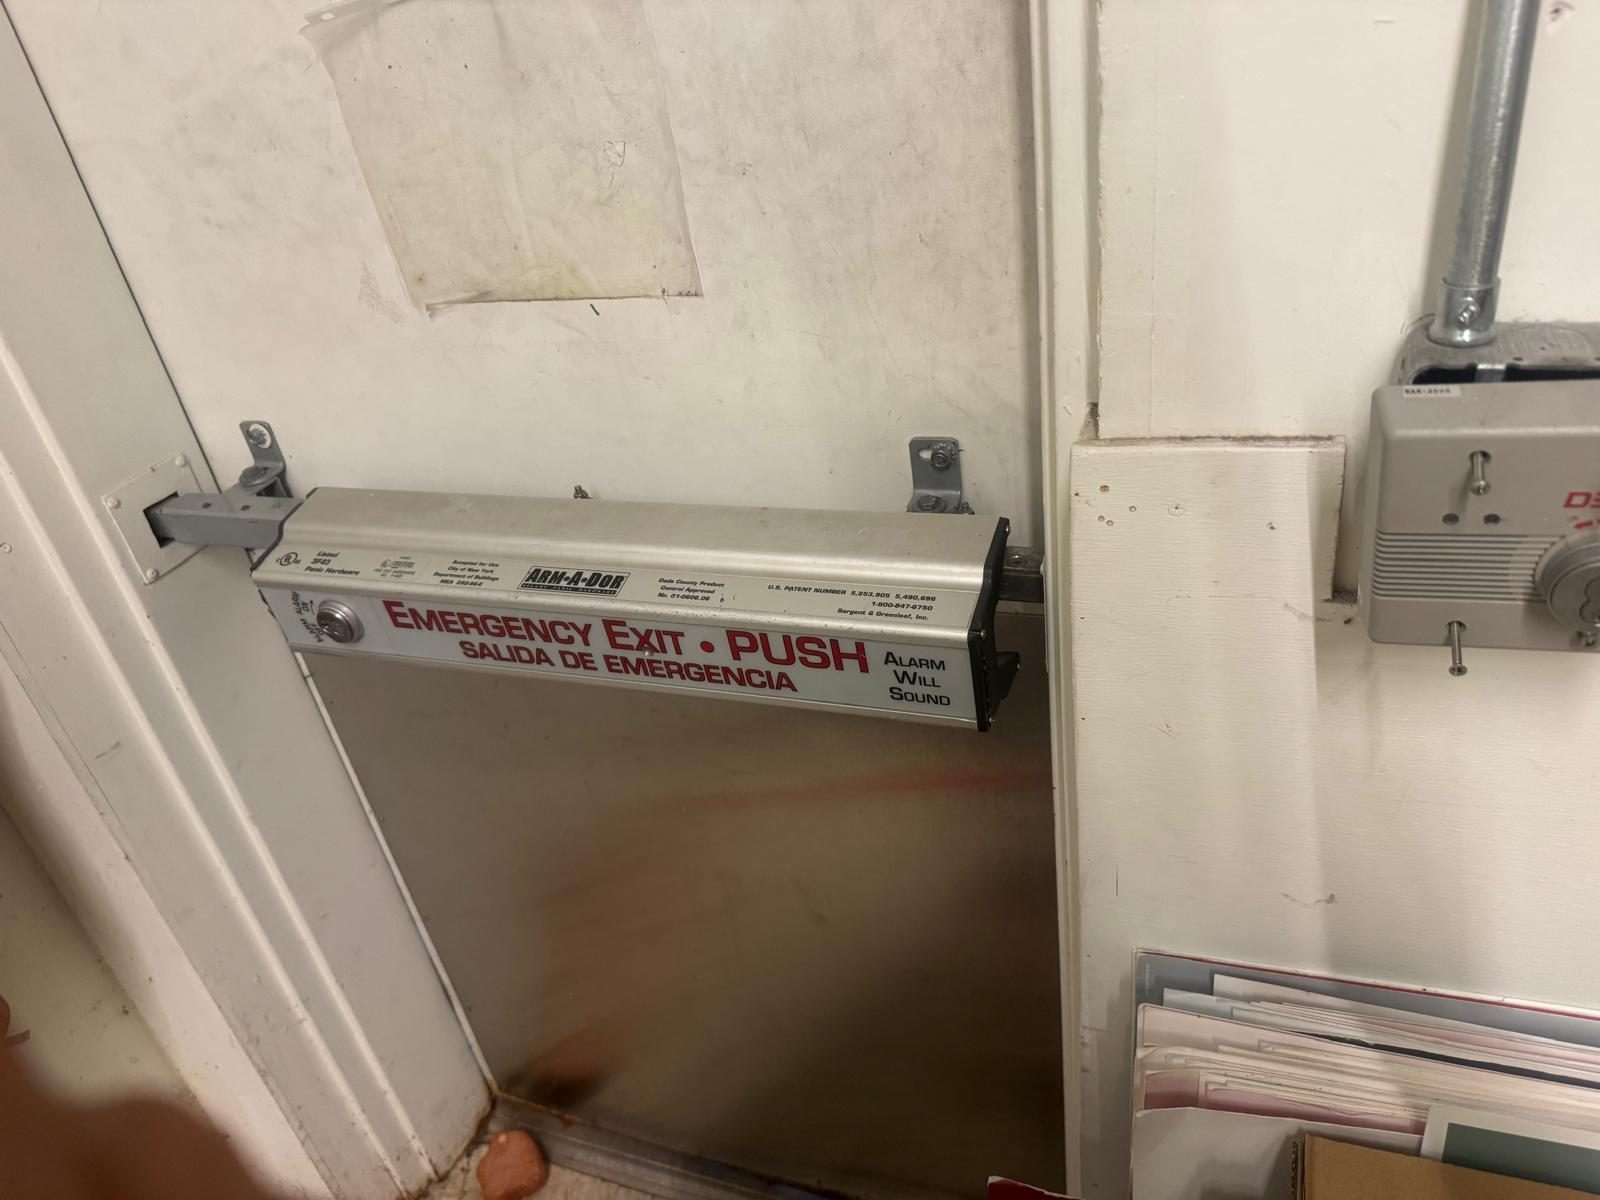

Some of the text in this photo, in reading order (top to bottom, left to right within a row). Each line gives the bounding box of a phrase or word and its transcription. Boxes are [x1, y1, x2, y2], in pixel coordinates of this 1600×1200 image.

[324, 568, 360, 576] Hardware
[675, 579, 699, 587] County
[699, 580, 725, 588] Product
[784, 585, 812, 593] PATENT
[813, 587, 847, 596] NUMBER
[837, 607, 866, 616] Sargent
[875, 611, 913, 620] Greenleaf,
[725, 629, 870, 674] PUSH
[459, 640, 799, 693] SALIDA DE EMERGENCIA
